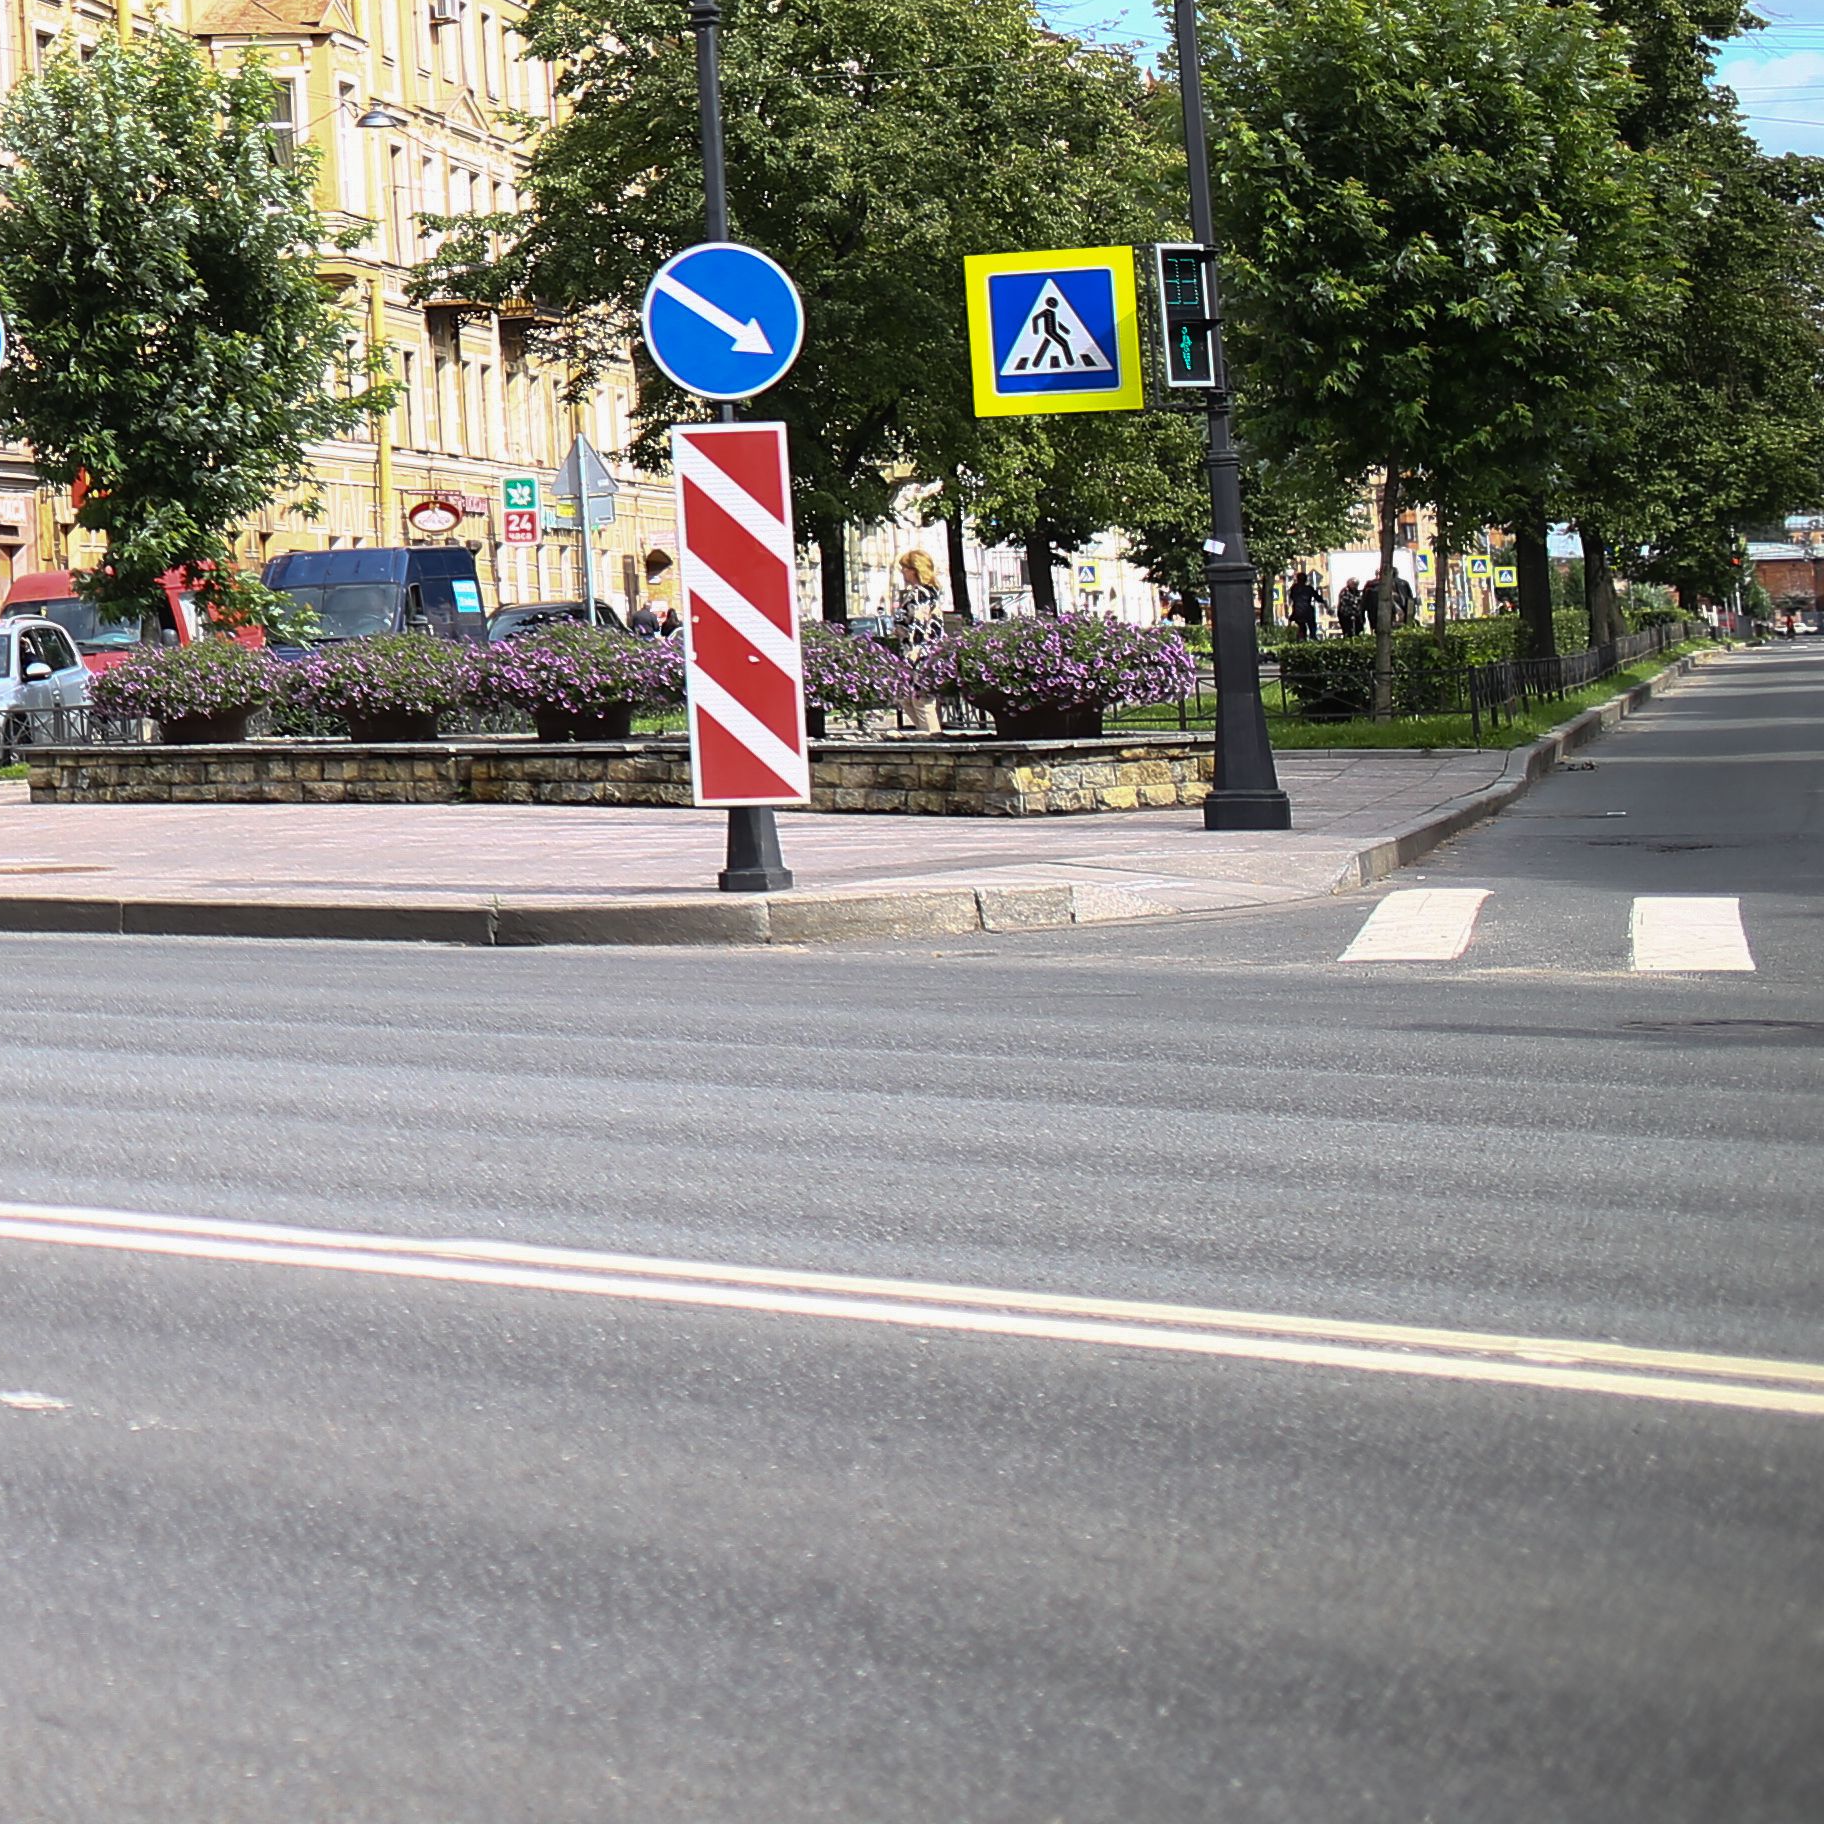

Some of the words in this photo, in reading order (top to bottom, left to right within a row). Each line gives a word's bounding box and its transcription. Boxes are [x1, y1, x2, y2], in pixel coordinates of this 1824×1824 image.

[1165, 257, 1199, 306] 33
[508, 514, 532, 531] 24
[508, 533, 533, 541] часа
